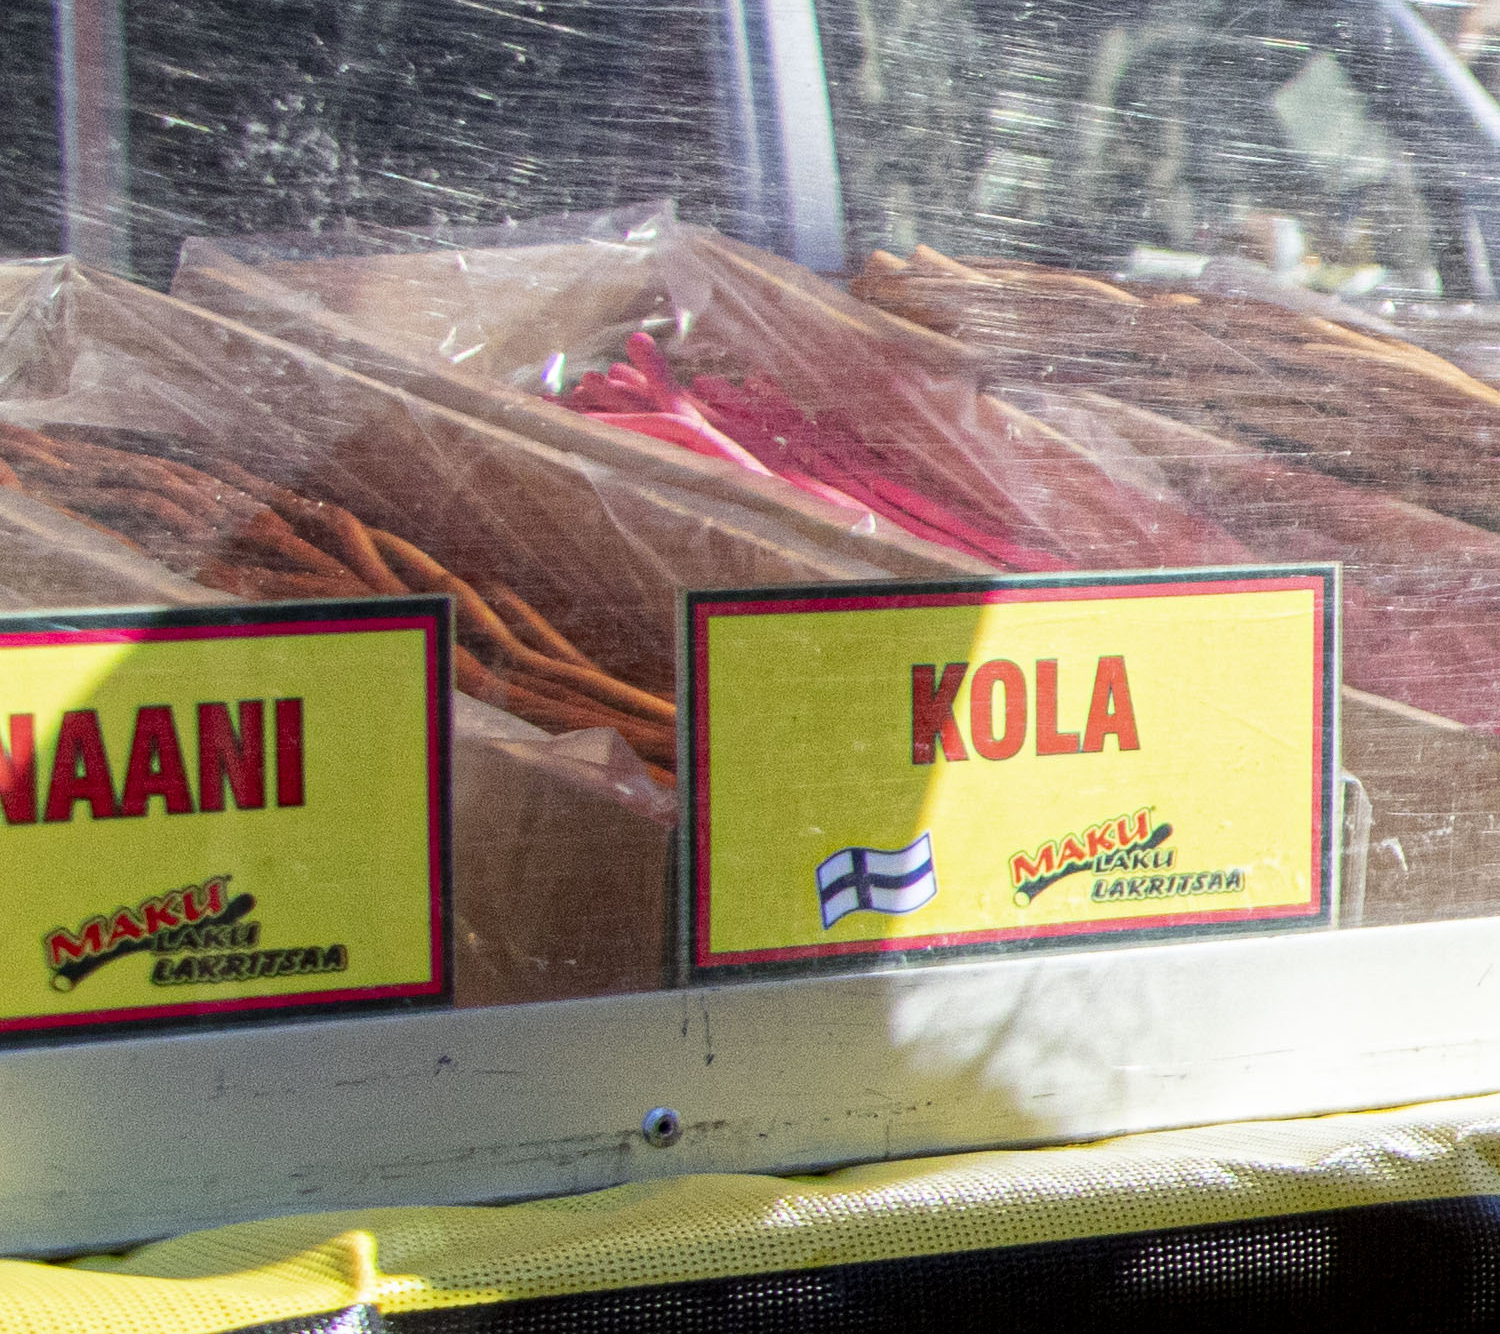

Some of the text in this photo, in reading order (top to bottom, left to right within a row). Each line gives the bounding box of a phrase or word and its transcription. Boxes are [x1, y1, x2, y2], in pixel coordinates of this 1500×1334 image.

[910, 654, 1141, 766] KOLA
[0, 697, 305, 827] NAANI
[1011, 809, 1150, 885] MAKU
[1094, 848, 1175, 875] LAKU
[1093, 869, 1243, 902] LAKRITSAA
[48, 879, 226, 967] MAKU
[154, 921, 261, 954] LAKU
[154, 945, 348, 985] LAKRITSAA
